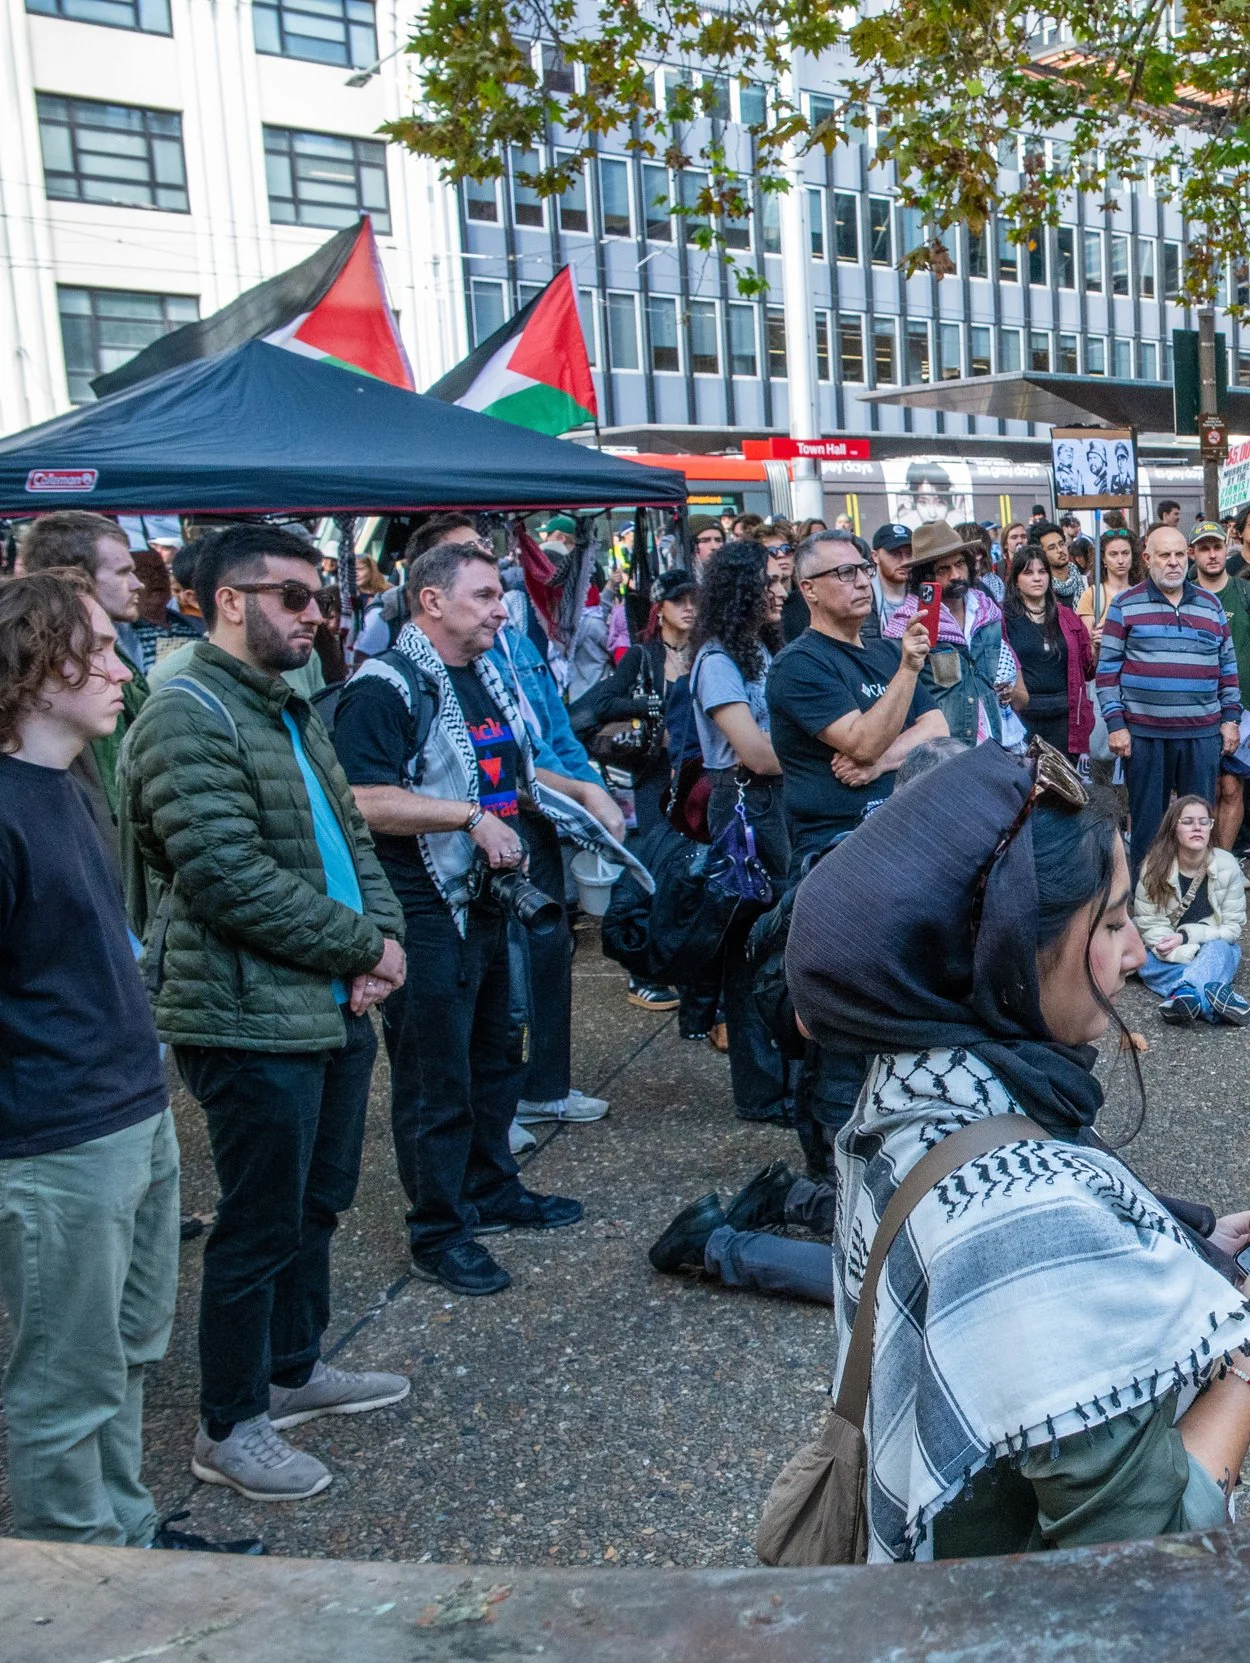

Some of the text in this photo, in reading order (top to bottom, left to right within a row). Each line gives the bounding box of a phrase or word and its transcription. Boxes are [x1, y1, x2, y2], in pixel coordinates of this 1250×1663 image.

[797, 443, 824, 455] Town
[826, 443, 847, 455] Hall
[1227, 472, 1246, 486] BY THE
[1221, 479, 1250, 498] ZIONIST
[1220, 492, 1248, 508] POISON
